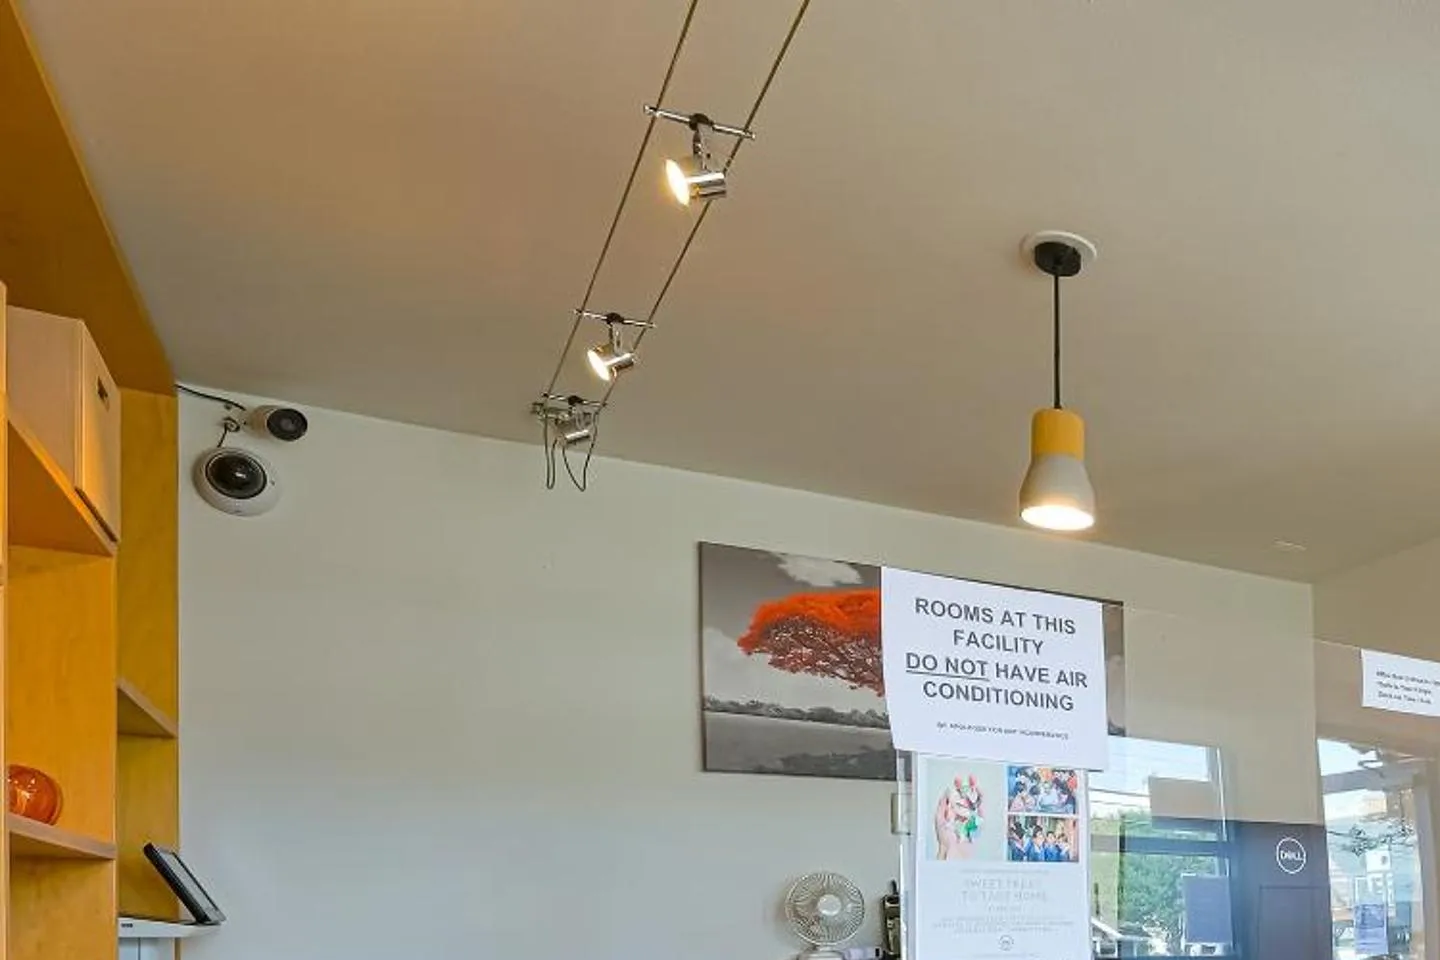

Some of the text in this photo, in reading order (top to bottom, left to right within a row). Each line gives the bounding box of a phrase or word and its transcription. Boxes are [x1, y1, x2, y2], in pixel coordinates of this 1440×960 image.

[914, 597, 1076, 635] ROOMS AT THIS
[953, 629, 1044, 656] FACILITY
[906, 652, 1088, 688] DO NOT HAVE AIR
[923, 681, 1074, 711] CONDITIONING
[1280, 850, 1303, 861] DELL
